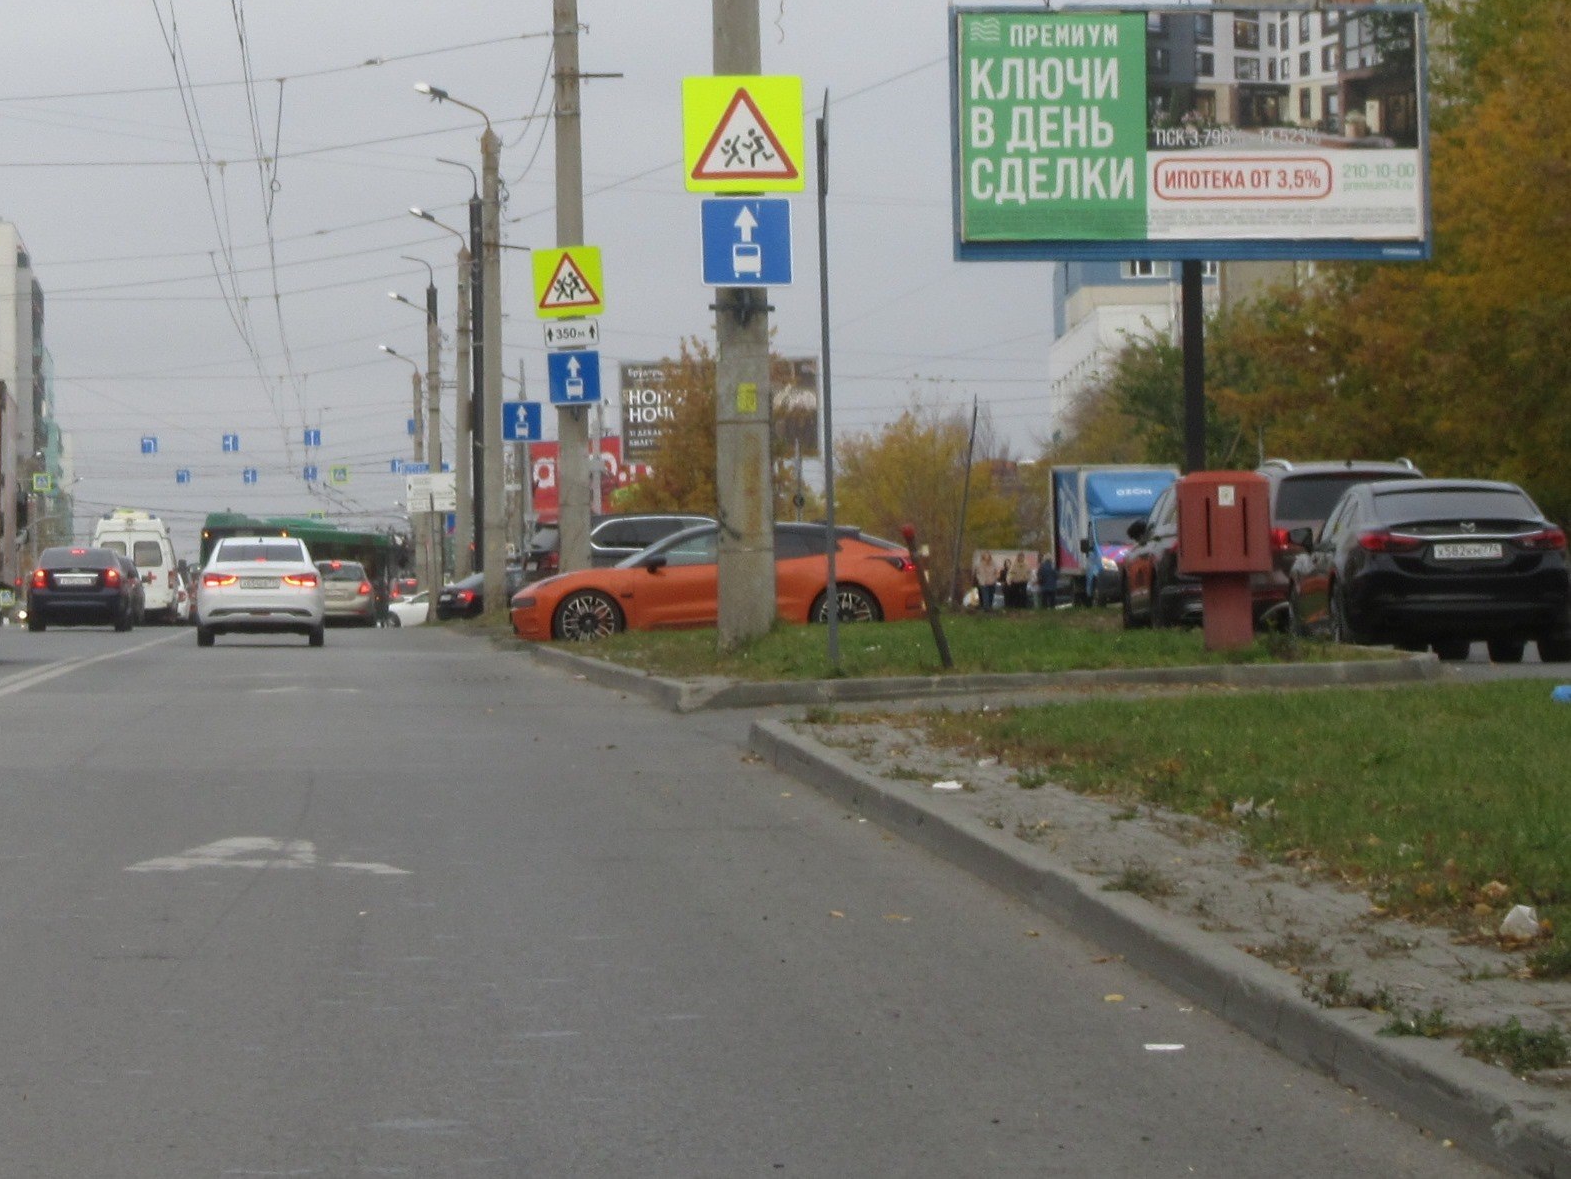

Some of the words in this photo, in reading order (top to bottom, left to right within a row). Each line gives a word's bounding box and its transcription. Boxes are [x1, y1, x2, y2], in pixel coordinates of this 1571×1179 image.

[1009, 24, 1119, 47] ПРЕМИУМ
[970, 57, 1119, 100] КЛЮЧИ
[970, 106, 996, 149] В
[1005, 105, 1115, 154] ДЕНЬ
[1155, 129, 1185, 147] ПСК
[970, 156, 1135, 206] СДЕЛКИ
[1164, 170, 1246, 190] ИПОТЕКА
[1250, 170, 1270, 189] ОТ
[1277, 169, 1322, 191] 3,5%
[556, 327, 577, 340] 350
